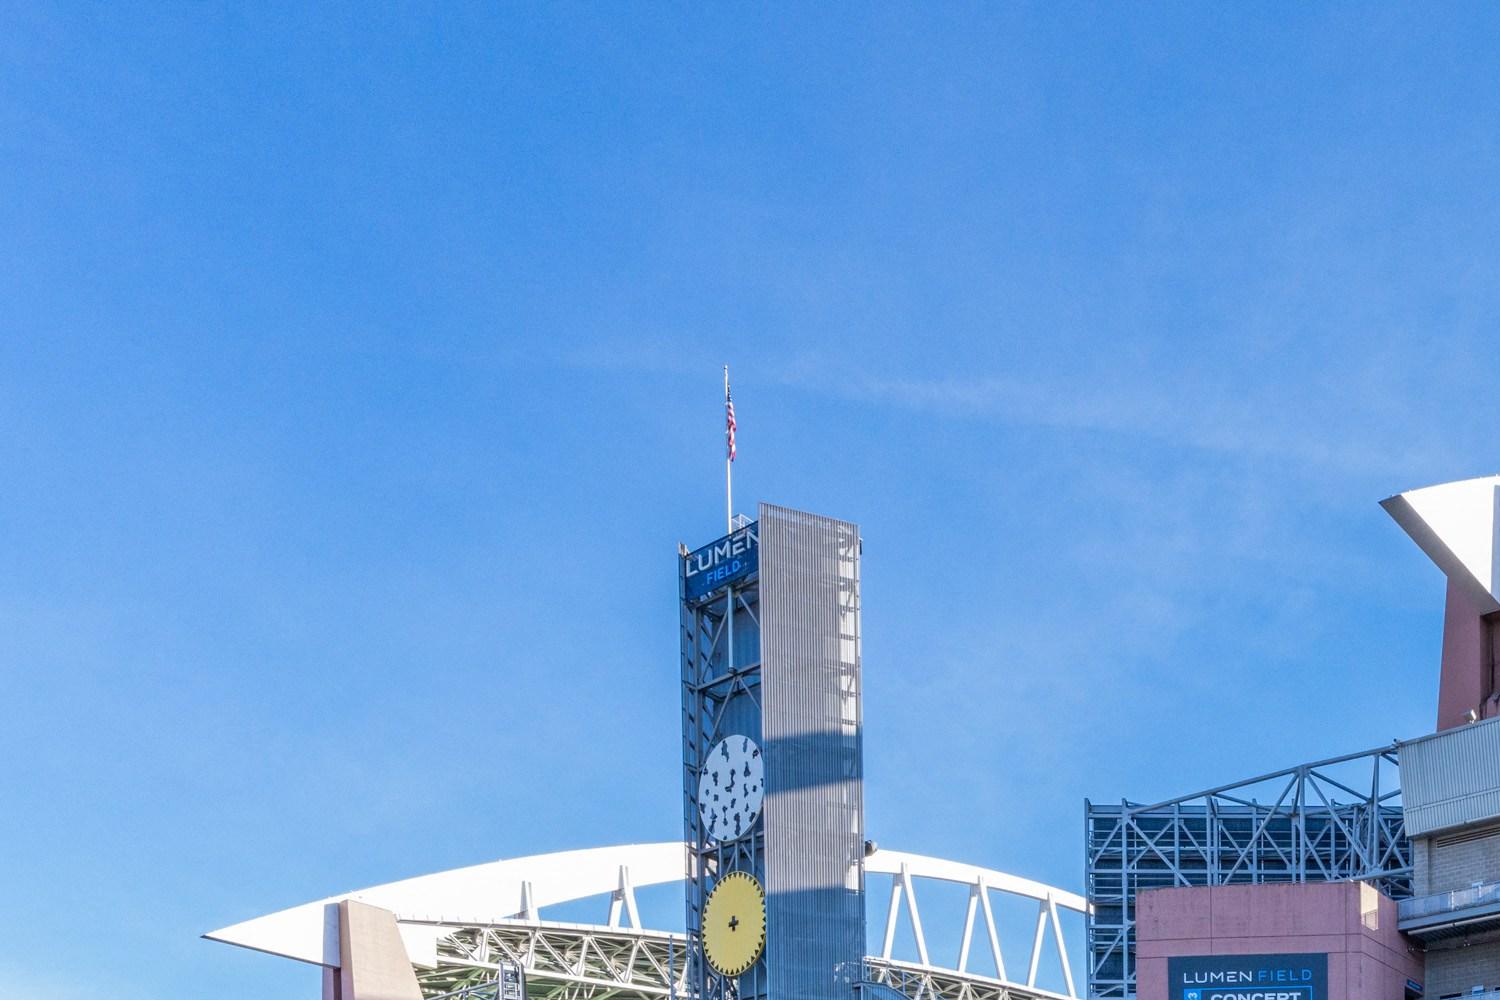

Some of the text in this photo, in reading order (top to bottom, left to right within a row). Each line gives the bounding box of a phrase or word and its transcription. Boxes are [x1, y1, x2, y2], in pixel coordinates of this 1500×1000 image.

[686, 529, 759, 578] LUMEN
[706, 560, 741, 585] FIELD
[1183, 969, 1312, 984] LUMEN FIELD
